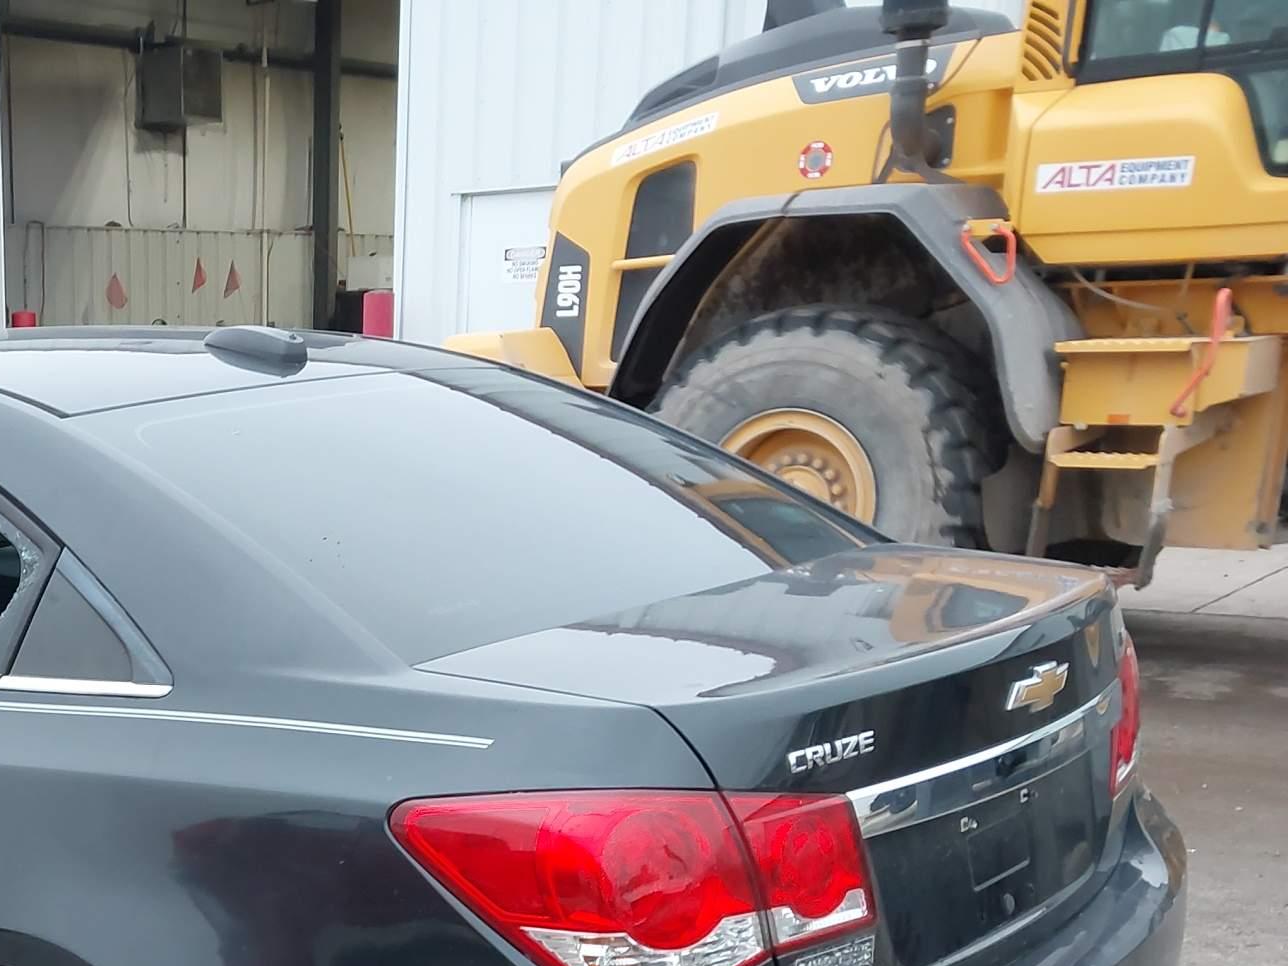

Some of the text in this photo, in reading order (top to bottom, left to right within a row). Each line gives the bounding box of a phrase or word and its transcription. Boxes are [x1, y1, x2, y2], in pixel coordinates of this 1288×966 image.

[1042, 163, 1117, 189] ALTA
[1120, 158, 1189, 173] EQUIPMENT
[1119, 173, 1187, 187] COMPANY
[555, 265, 582, 318] L90H
[787, 730, 875, 774] CRUZE
